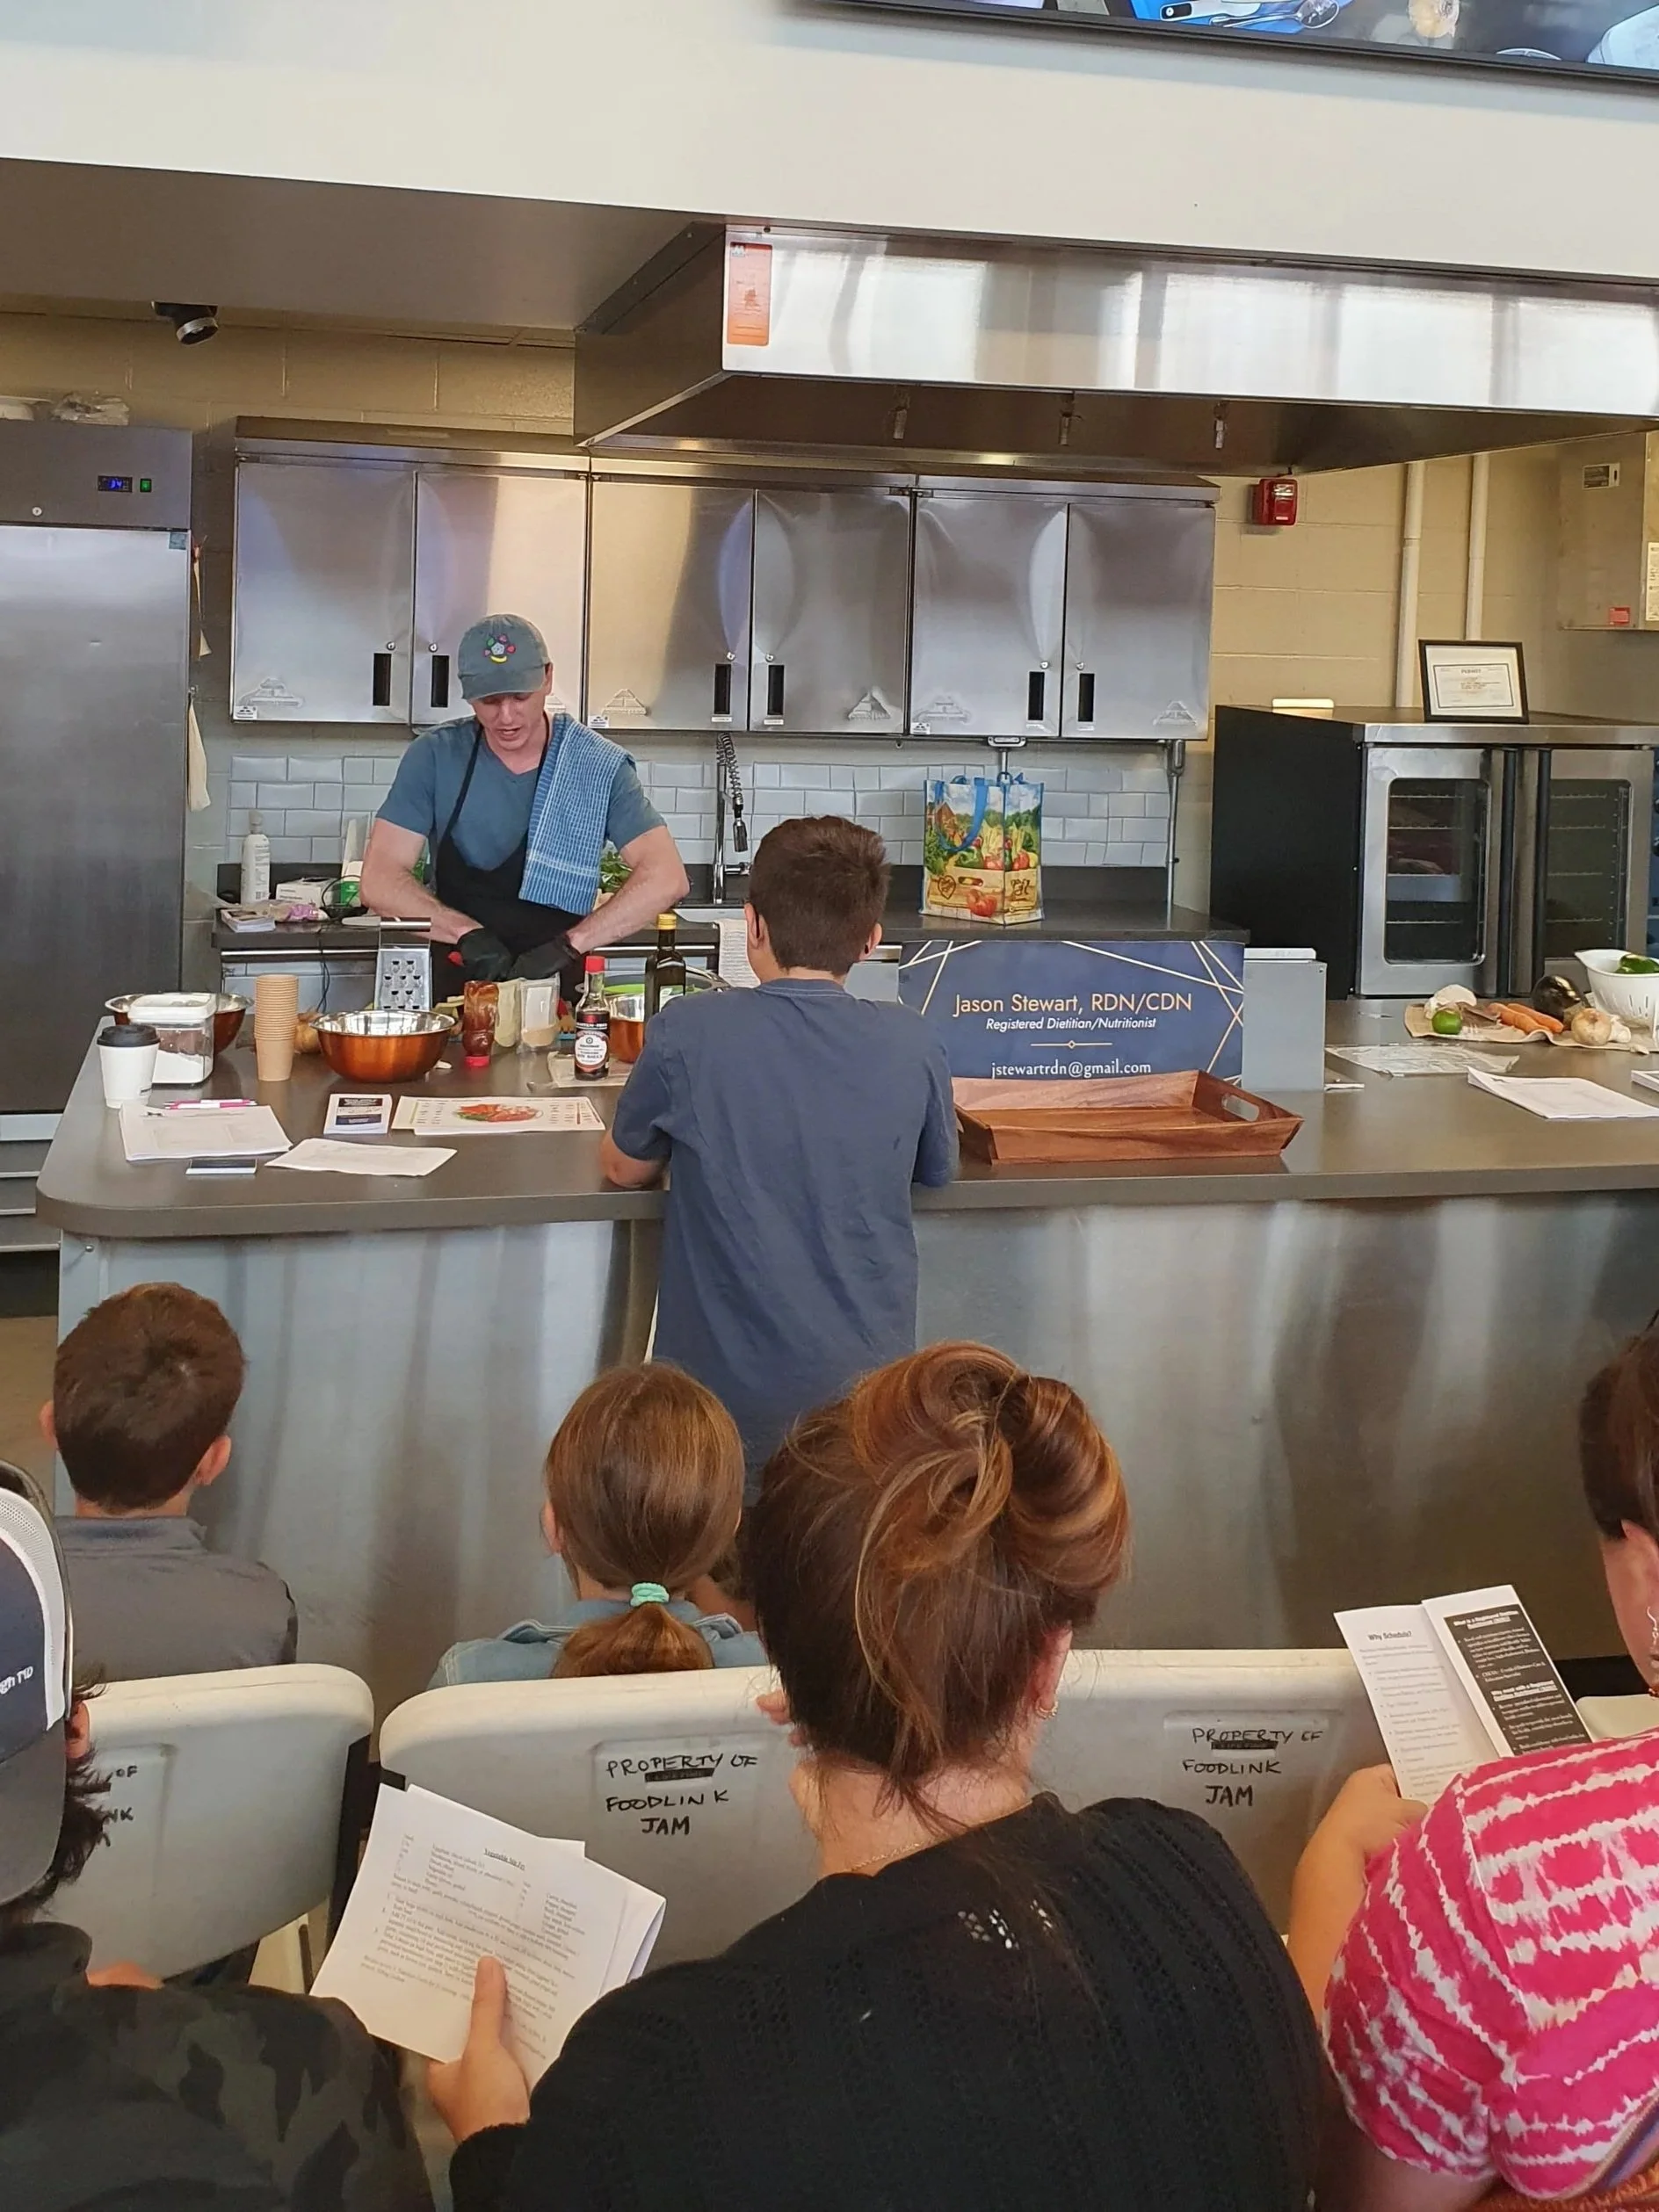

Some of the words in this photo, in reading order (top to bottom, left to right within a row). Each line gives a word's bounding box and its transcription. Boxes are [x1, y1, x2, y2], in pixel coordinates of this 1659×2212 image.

[953, 994, 1004, 1017] Jason
[1011, 993, 1083, 1014] Stewart,
[1090, 991, 1193, 1014] RDN/CDN
[986, 1016, 1044, 1031] Registered
[1047, 1016, 1156, 1030] Dietitian/Nutritionist
[990, 1059, 1152, 1080] jstewartrdn@gmail.com
[1192, 1727, 1293, 1745] PROPERTY
[606, 1753, 724, 1778] PROPERTY
[730, 1753, 758, 1768] OF
[1182, 1759, 1282, 1775] FOODLINK
[1205, 1784, 1253, 1807] JAM
[641, 1815, 690, 1835] JAM
